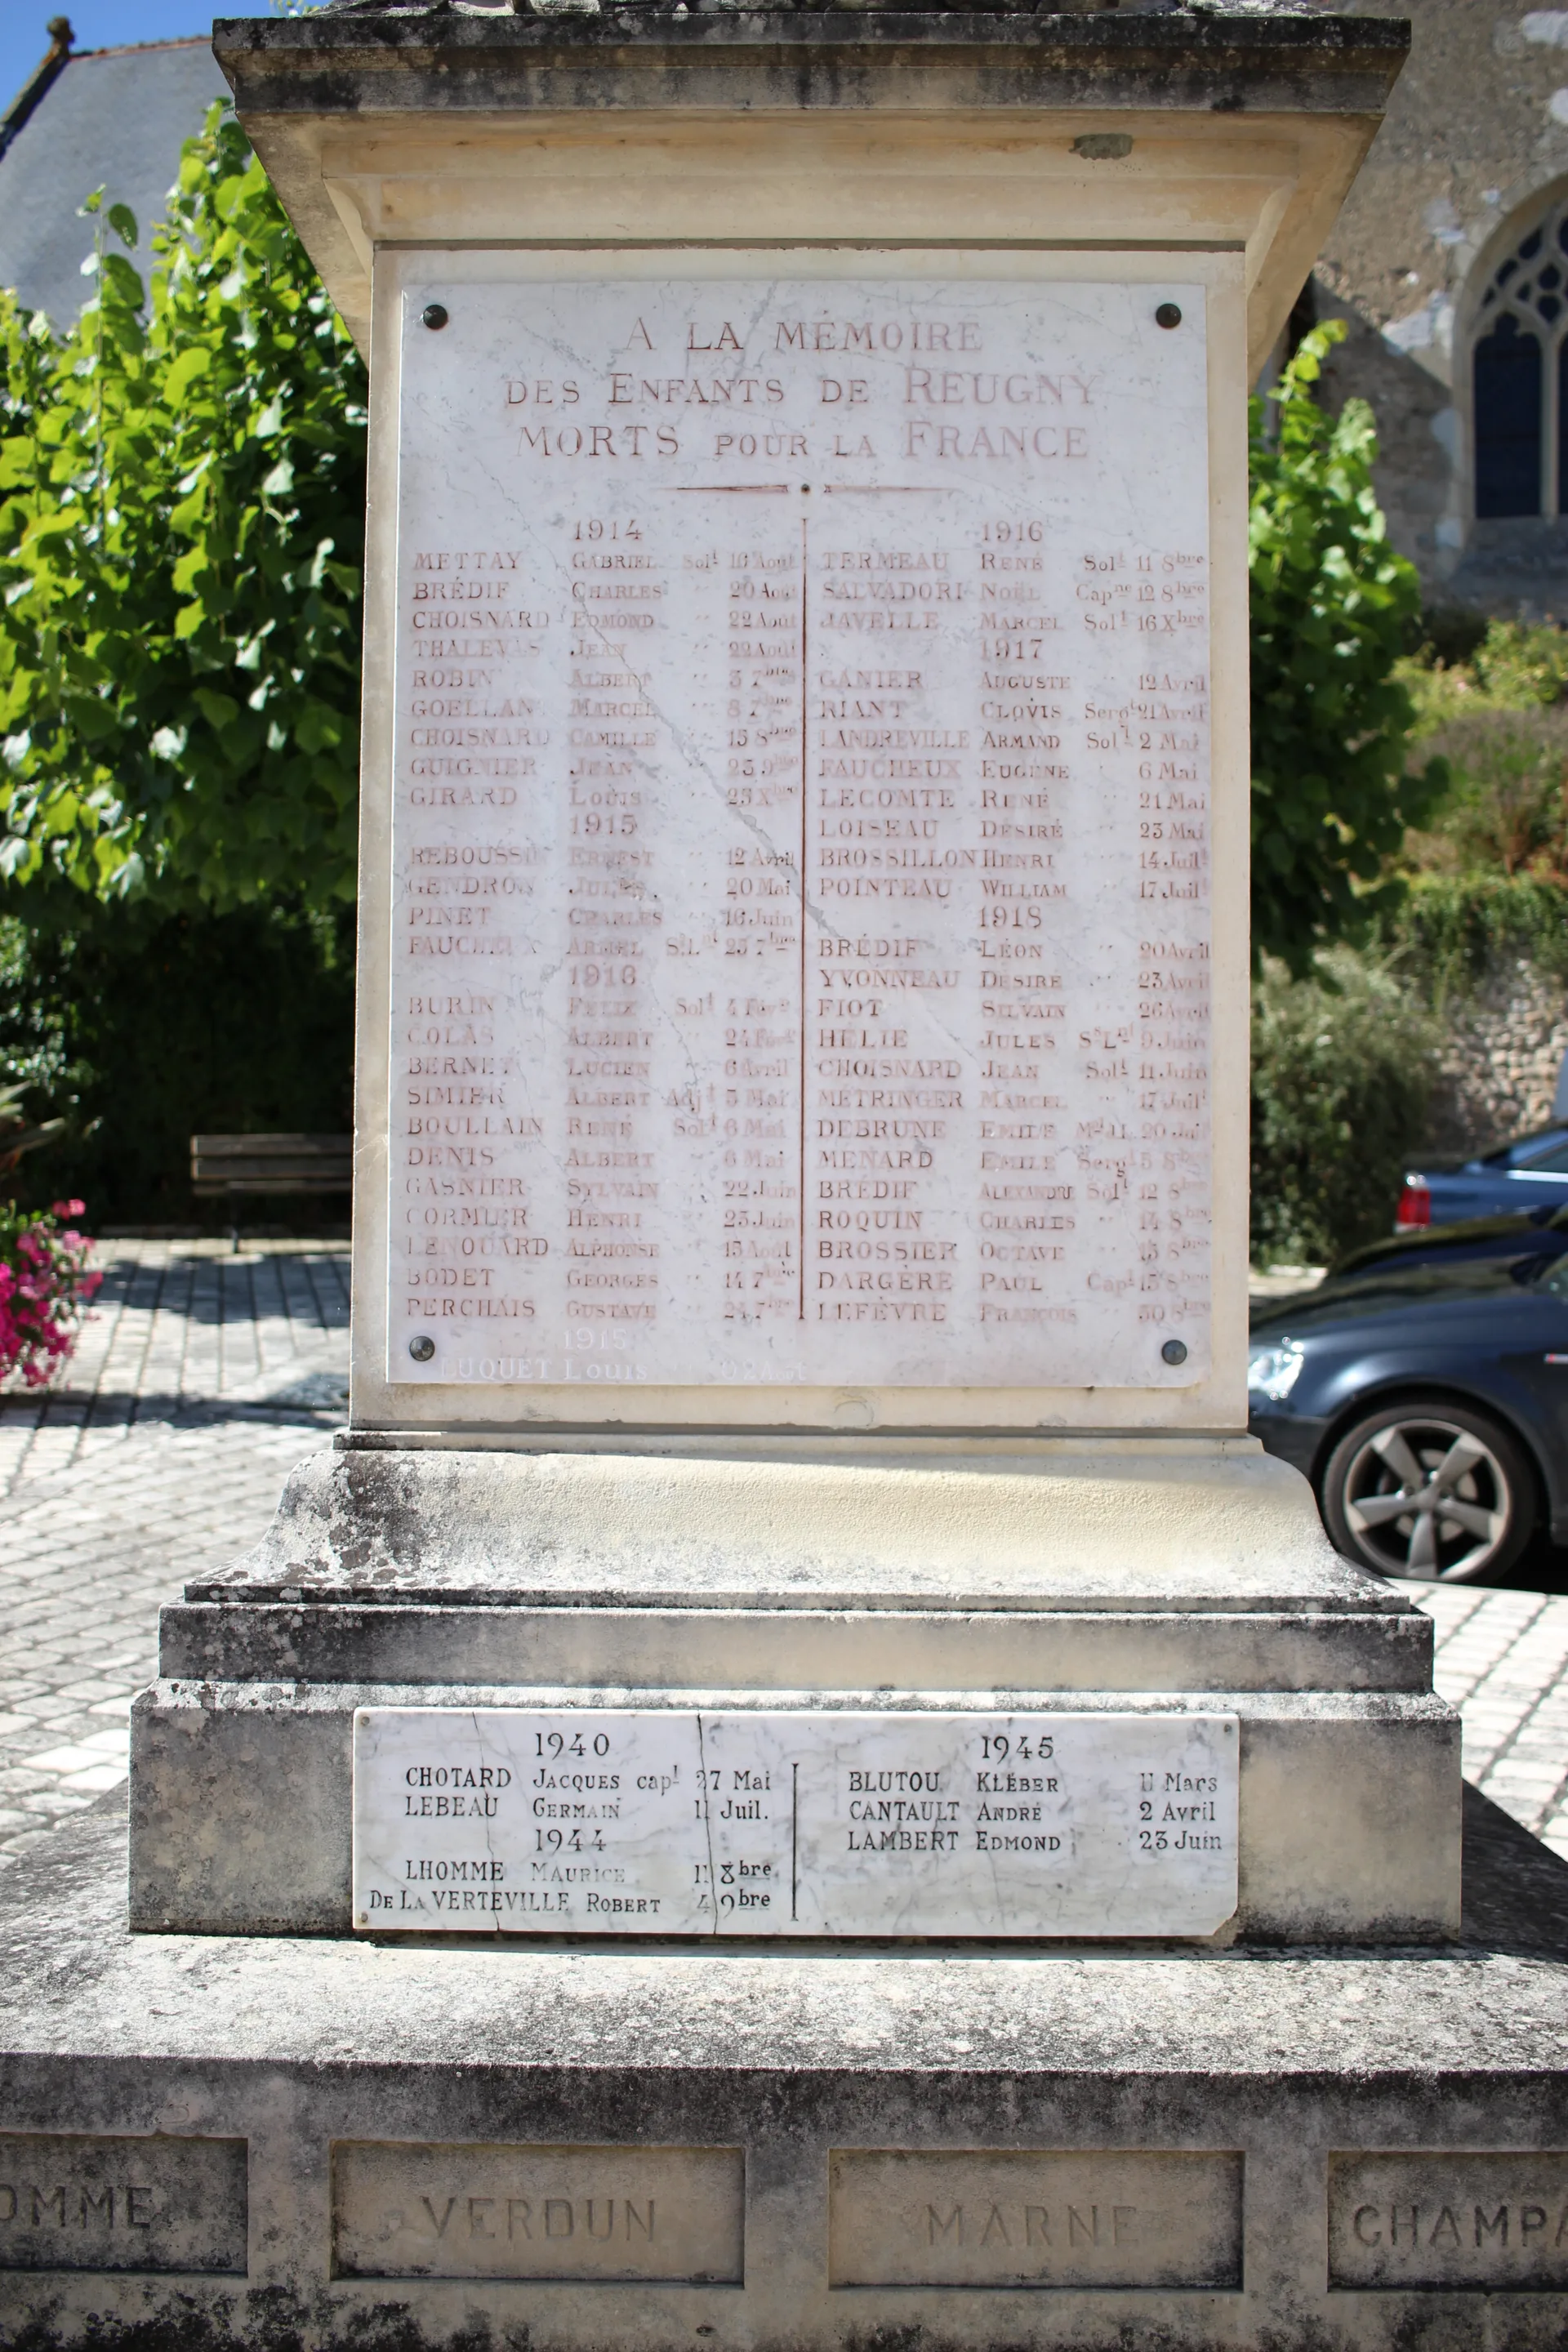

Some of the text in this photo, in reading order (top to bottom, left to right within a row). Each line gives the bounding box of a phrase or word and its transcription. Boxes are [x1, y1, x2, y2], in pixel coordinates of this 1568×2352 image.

[625, 309, 982, 351] A LA MÉMOIRE
[505, 367, 1098, 404] DES ENFANTS DE REUGNY
[517, 421, 1088, 457] MORTS POUR LA FRANCE
[574, 520, 642, 540] 1914
[982, 521, 1044, 542] 1916
[413, 552, 658, 570] METTAY GABRIEL
[822, 552, 1044, 571] TERMEAU RENÉ
[413, 577, 662, 599] BRÉDIF CHARLES
[822, 581, 963, 600] SALVADORI
[412, 611, 653, 628] CHOISNARD EDMOND
[821, 612, 1066, 630] JAVELLE MARCEL
[570, 639, 627, 657] JEAN
[980, 639, 1044, 659] 1917
[412, 668, 652, 688] ROBIN ALBERT
[820, 670, 1071, 689] GANIER AUGUSTE
[569, 697, 657, 717] MARCEL
[821, 701, 1062, 719] RIANT CLOVIS
[411, 728, 656, 746] CHOISNARD CAMILLE
[819, 730, 969, 748] LANDREVILLE
[982, 731, 1060, 748] ARMAND
[1139, 733, 1152, 749] 2
[411, 758, 633, 776] GUIGNIER JEAN
[819, 760, 1198, 780] FAUCHEUX 6 Mai
[410, 787, 517, 805] GIRARD
[820, 787, 1205, 809] LECOMTE RENÉ 21 Mai
[571, 814, 637, 834] 1915
[820, 819, 1204, 840] LOISEAU 23 Mai
[570, 847, 654, 866] ERNEST
[820, 849, 1055, 868] BROSSILLON HENRI
[408, 876, 791, 895] GENDRON 20 Mai
[820, 879, 1067, 897] POINTEAU WILLIAM
[409, 906, 490, 924] PINET
[979, 906, 1042, 928] 1918
[819, 935, 1042, 957] BRÉDIF LÉON
[569, 964, 636, 986] 1916
[819, 969, 960, 988] YVONNEAU
[409, 996, 494, 1014] BURIN
[818, 1000, 1066, 1018] FIOT SILVAIN
[408, 1026, 653, 1045] COLAS ALBERT
[981, 1031, 1055, 1048] JULES
[409, 1057, 650, 1076] BERNET LUCIEN
[819, 1060, 1039, 1078] CHOISNARD JEAN
[408, 1087, 651, 1107] SIMIER ALBERT
[819, 1090, 1067, 1108] METRINGER MARCEL
[408, 1117, 543, 1135] BOULLAIN
[818, 1120, 946, 1138] DEBRUNE
[408, 1147, 654, 1167] DENIS ALBERT
[407, 1178, 658, 1197] GASNIER SYLVAIN
[407, 1208, 642, 1227] CORMIER HENRI
[819, 1211, 1074, 1232] ROQUIN CHARLES
[566, 1238, 659, 1257] ALPHONSE
[819, 1241, 1064, 1260] BROSSIER OCTAVE
[408, 1269, 658, 1288] BODET GEORGES
[980, 1272, 1042, 1290] PAUL
[408, 1298, 656, 1319] PERCHAIS GUSTAVE
[564, 1328, 626, 1350] 1915
[441, 1359, 551, 1380] LUQUET
[536, 1733, 609, 1758] 1940
[982, 1735, 1054, 1761] 1945
[406, 1767, 772, 1791] CHOTARD JACQUES 27 Mai
[849, 1771, 940, 1793] BLUTOU
[977, 1772, 1058, 1793] KLÉBER
[1164, 1772, 1218, 1793] Mars
[405, 1796, 499, 1817] LEBEAU
[532, 1798, 620, 1819] GERMAIN
[720, 1799, 769, 1820] Juil.
[849, 1801, 1216, 1822] CANTAULT ANDRÉ 2 Avril
[535, 1828, 607, 1855] 1944
[848, 1831, 1223, 1851] LAMBERT EDMOND 23 Juin
[406, 1860, 504, 1881] LHOMME
[531, 1861, 626, 1883] MAURICE
[434, 1891, 569, 1912] VERTEVILLE
[587, 1895, 661, 1913] ROBERT
[421, 2195, 657, 2243] VERDUN
[924, 2202, 1141, 2248] MARNE
